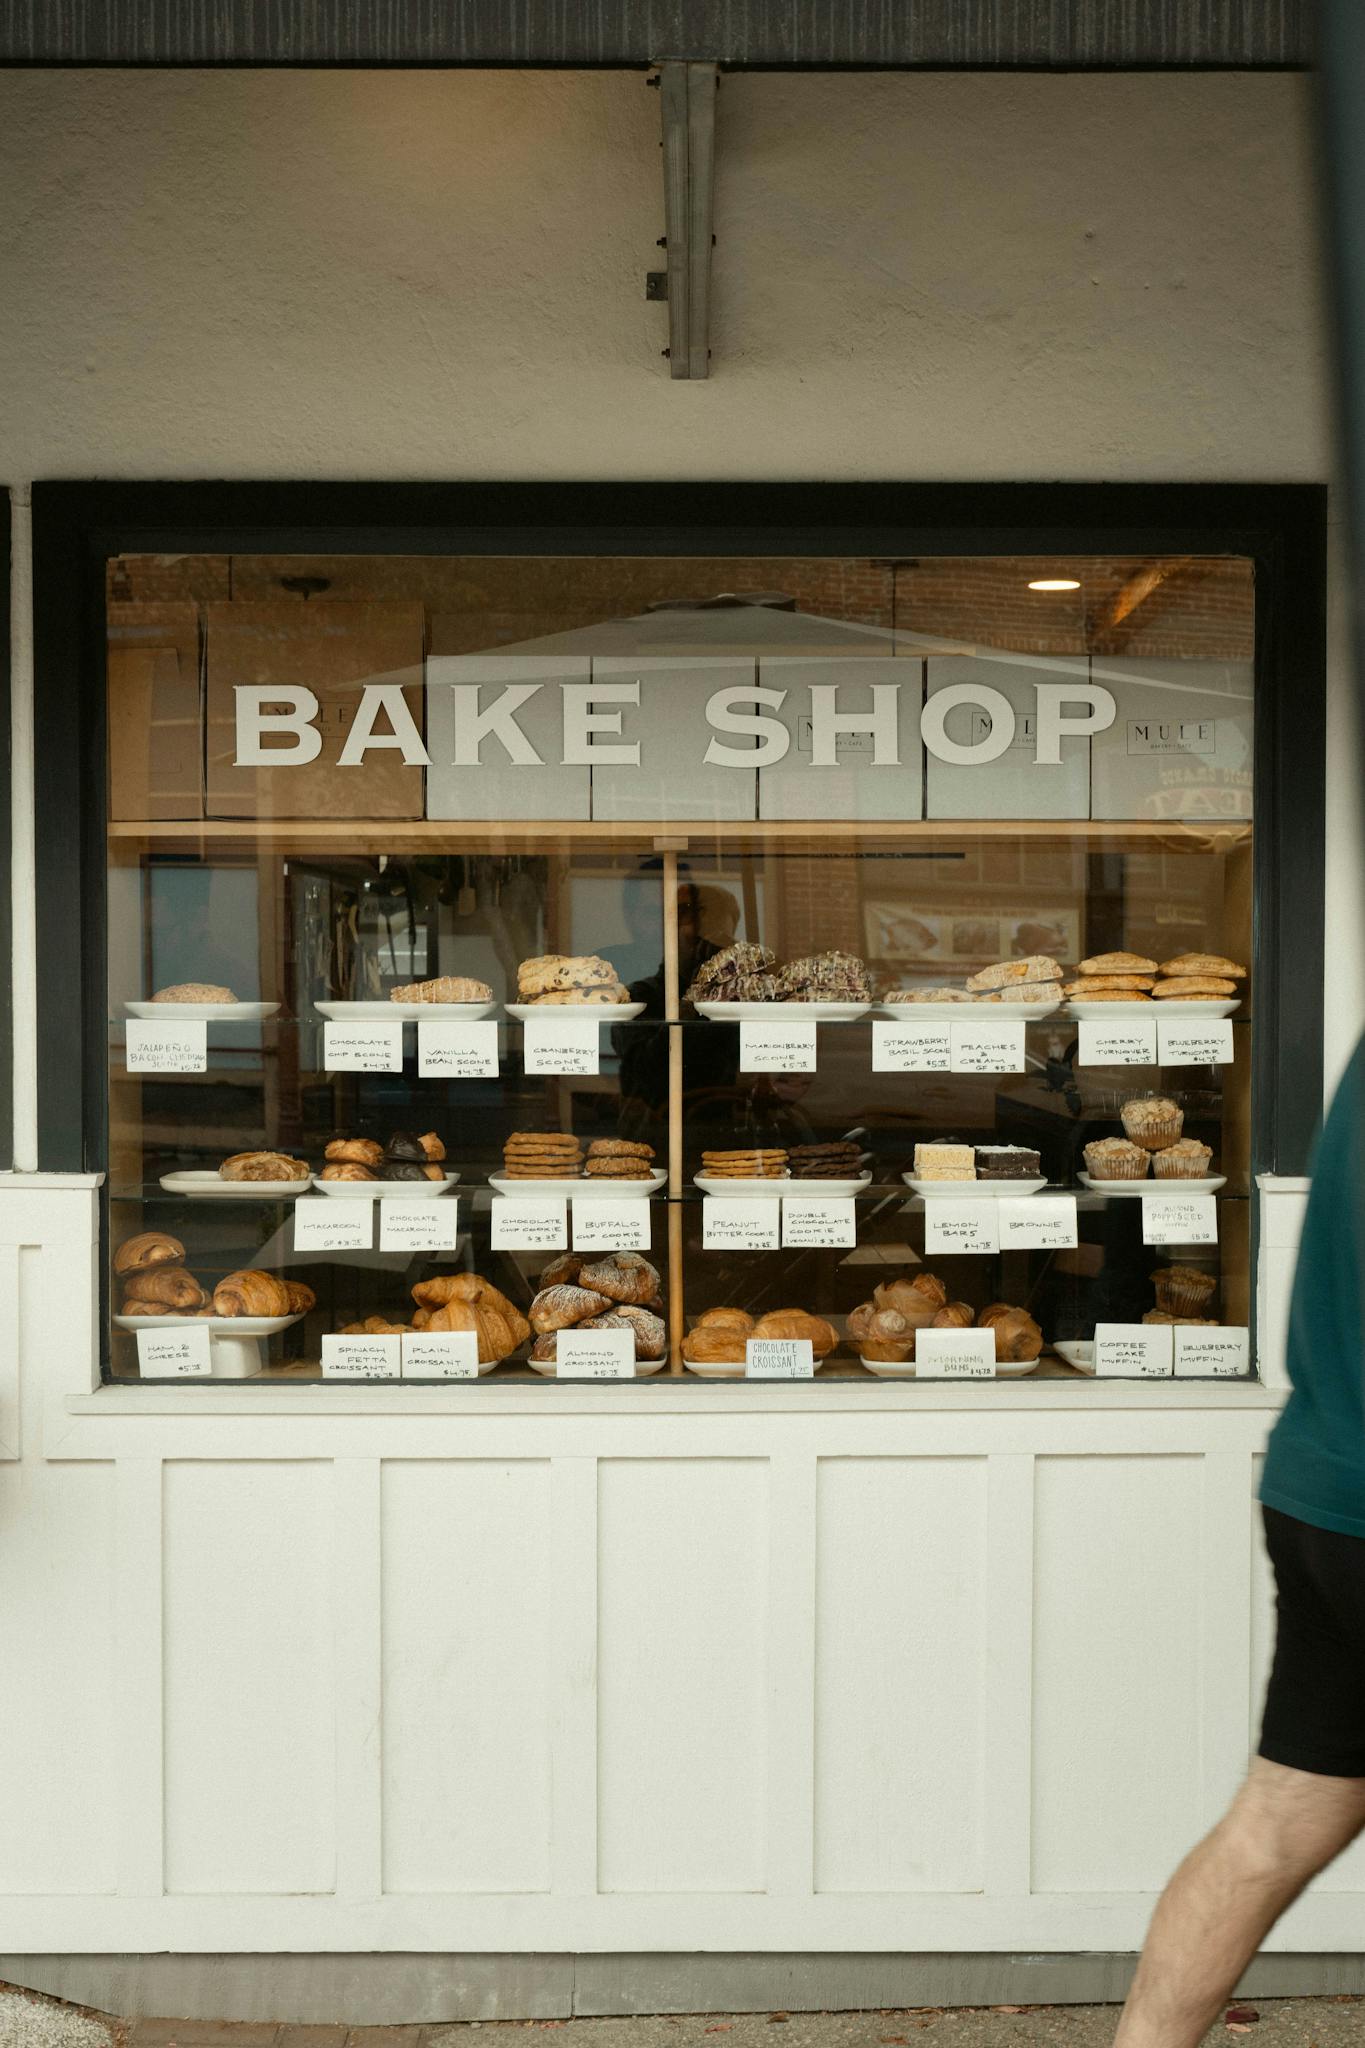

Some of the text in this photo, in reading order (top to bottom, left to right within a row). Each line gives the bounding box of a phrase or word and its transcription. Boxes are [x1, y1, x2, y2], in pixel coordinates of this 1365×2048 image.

[232, 680, 1117, 768] BAKE SHOP
[1135, 725, 1208, 741] MULE
[883, 1038, 949, 1047] STRAWBERRY
[533, 1048, 596, 1057] CRANBERRY
[130, 1053, 164, 1063] BACON
[536, 1058, 581, 1066] SCONE
[585, 1221, 640, 1229] BUFFALO
[712, 1221, 760, 1229] PEANUT
[934, 1221, 979, 1229] LEMON
[1009, 1221, 1063, 1229] BROWNIE
[147, 1345, 176, 1353] HAM
[753, 1342, 797, 1354] CHOCOLATE
[148, 1352, 190, 1360] CHEESE
[752, 1355, 797, 1368] CROISSANT
